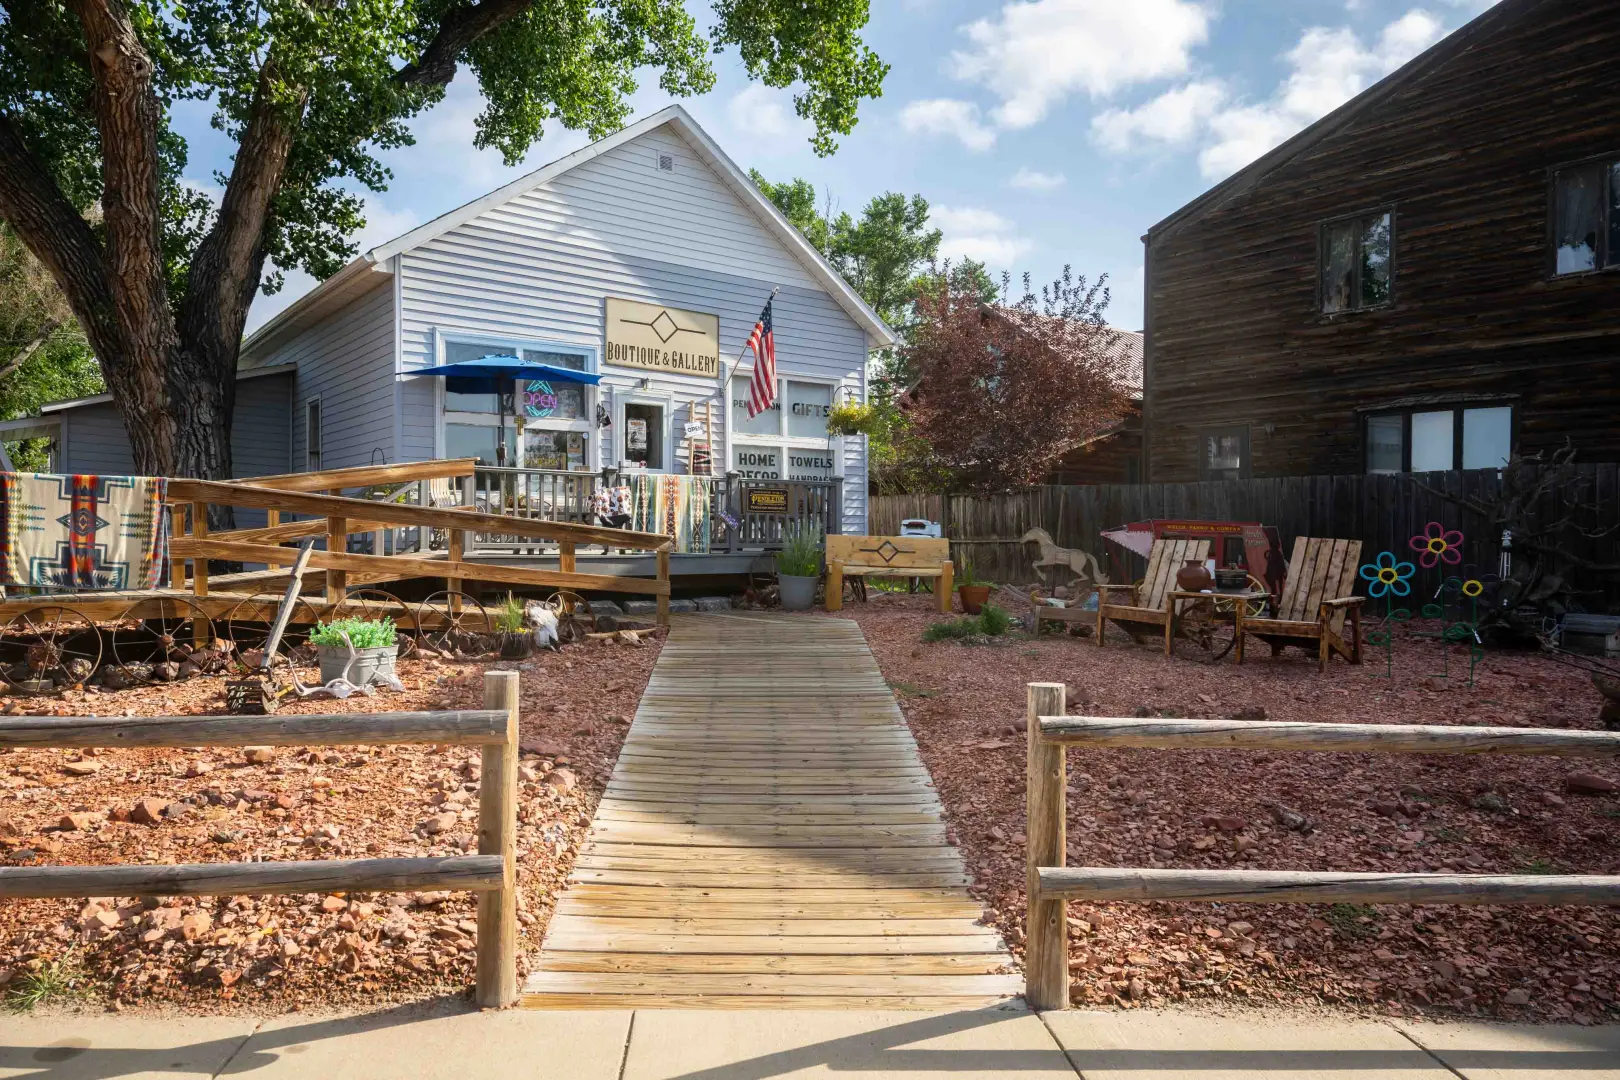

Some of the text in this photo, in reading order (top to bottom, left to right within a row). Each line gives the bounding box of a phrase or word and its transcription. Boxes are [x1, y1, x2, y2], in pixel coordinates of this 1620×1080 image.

[607, 341, 716, 373] BOUTIQUE & GALLERY
[521, 390, 557, 409] OPEN
[792, 403, 830, 418] GIFTS
[738, 452, 776, 467] HOME
[789, 456, 833, 469] TOWELS
[751, 494, 785, 504] PENDLETON
